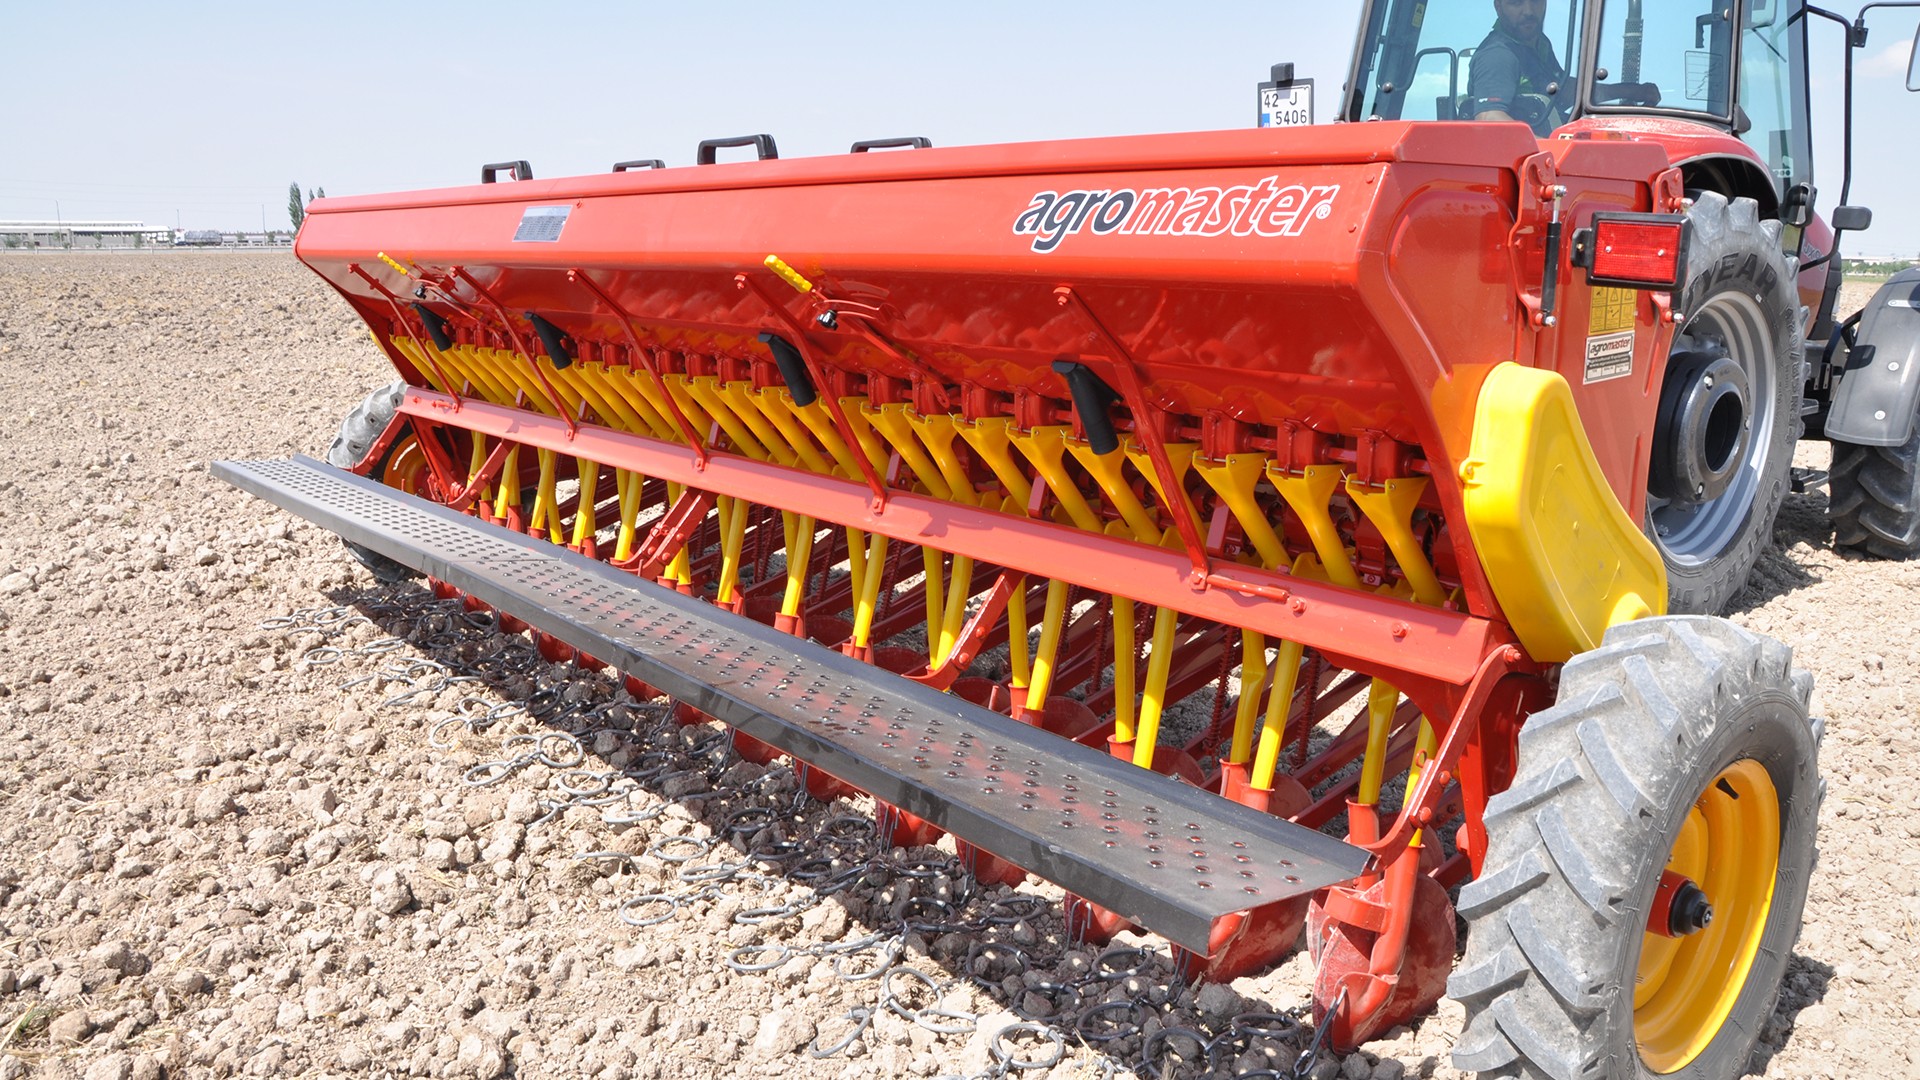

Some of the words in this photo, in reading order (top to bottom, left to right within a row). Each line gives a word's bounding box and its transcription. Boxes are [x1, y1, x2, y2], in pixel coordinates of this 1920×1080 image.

[1264, 93, 1279, 108] 42
[1289, 91, 1298, 106] J
[1275, 109, 1307, 125] 5406
[1013, 175, 1341, 253] agromaster
[1590, 338, 1631, 356] agromaster
